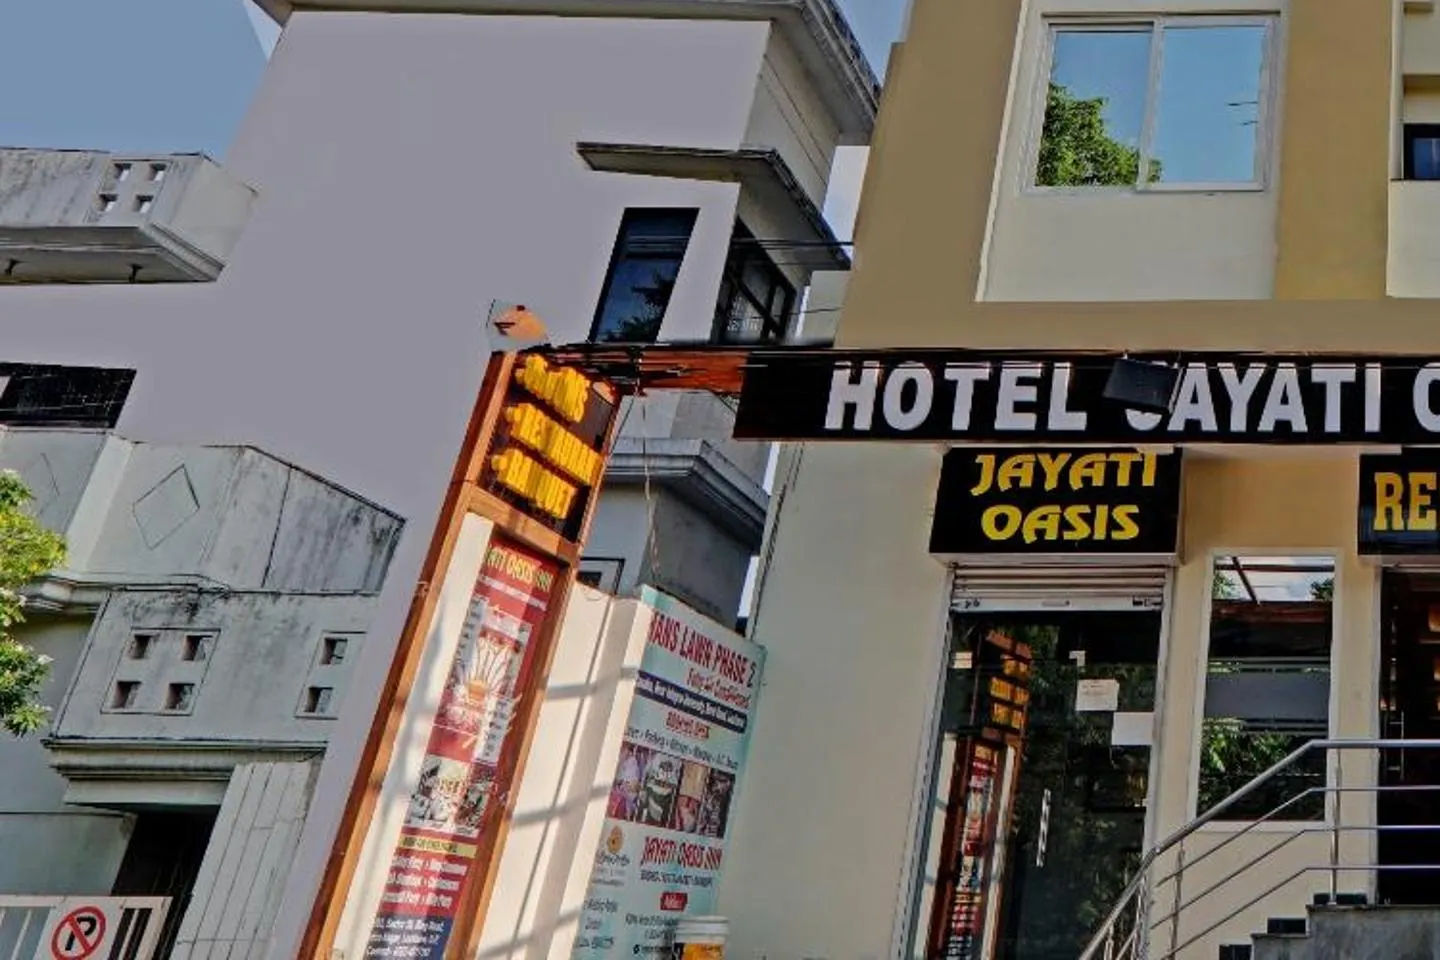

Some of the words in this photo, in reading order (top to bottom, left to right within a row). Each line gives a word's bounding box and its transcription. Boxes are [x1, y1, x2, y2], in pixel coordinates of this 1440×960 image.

[823, 360, 1087, 432] HOTEL
[969, 451, 1158, 497] JAYATI
[980, 502, 1141, 545] OASIS
